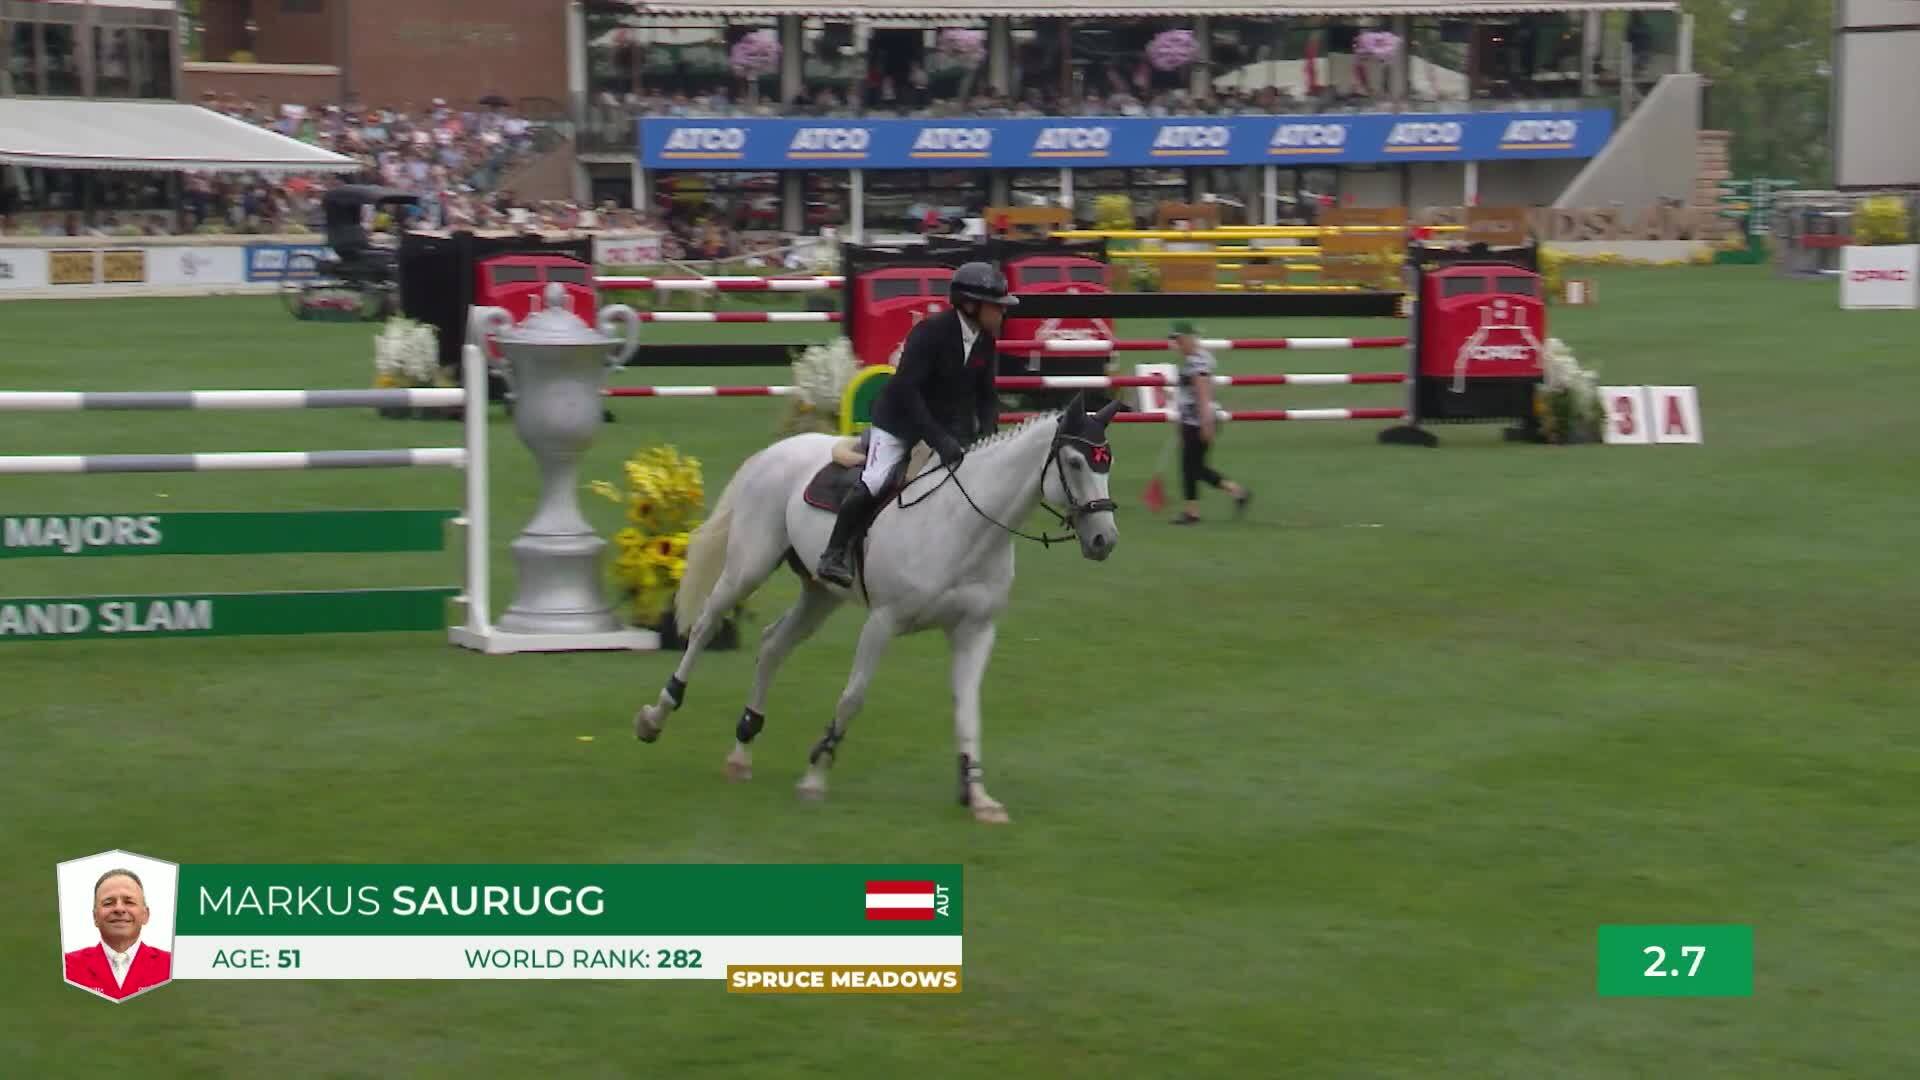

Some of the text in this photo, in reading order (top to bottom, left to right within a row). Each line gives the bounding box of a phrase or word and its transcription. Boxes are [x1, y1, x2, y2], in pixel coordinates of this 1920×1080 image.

[664, 127, 745, 150] ATCO
[790, 127, 870, 150] ATCO
[913, 127, 992, 150] ATCO
[1034, 126, 1112, 150] ATCO
[1153, 125, 1230, 148] ATCO
[1271, 123, 1346, 147] ATCO
[1386, 121, 1462, 145] ATCO
[1502, 119, 1577, 143] ATCO
[1664, 396, 1688, 434] A
[3, 515, 162, 553] MAJORS
[98, 599, 212, 633] SLAM
